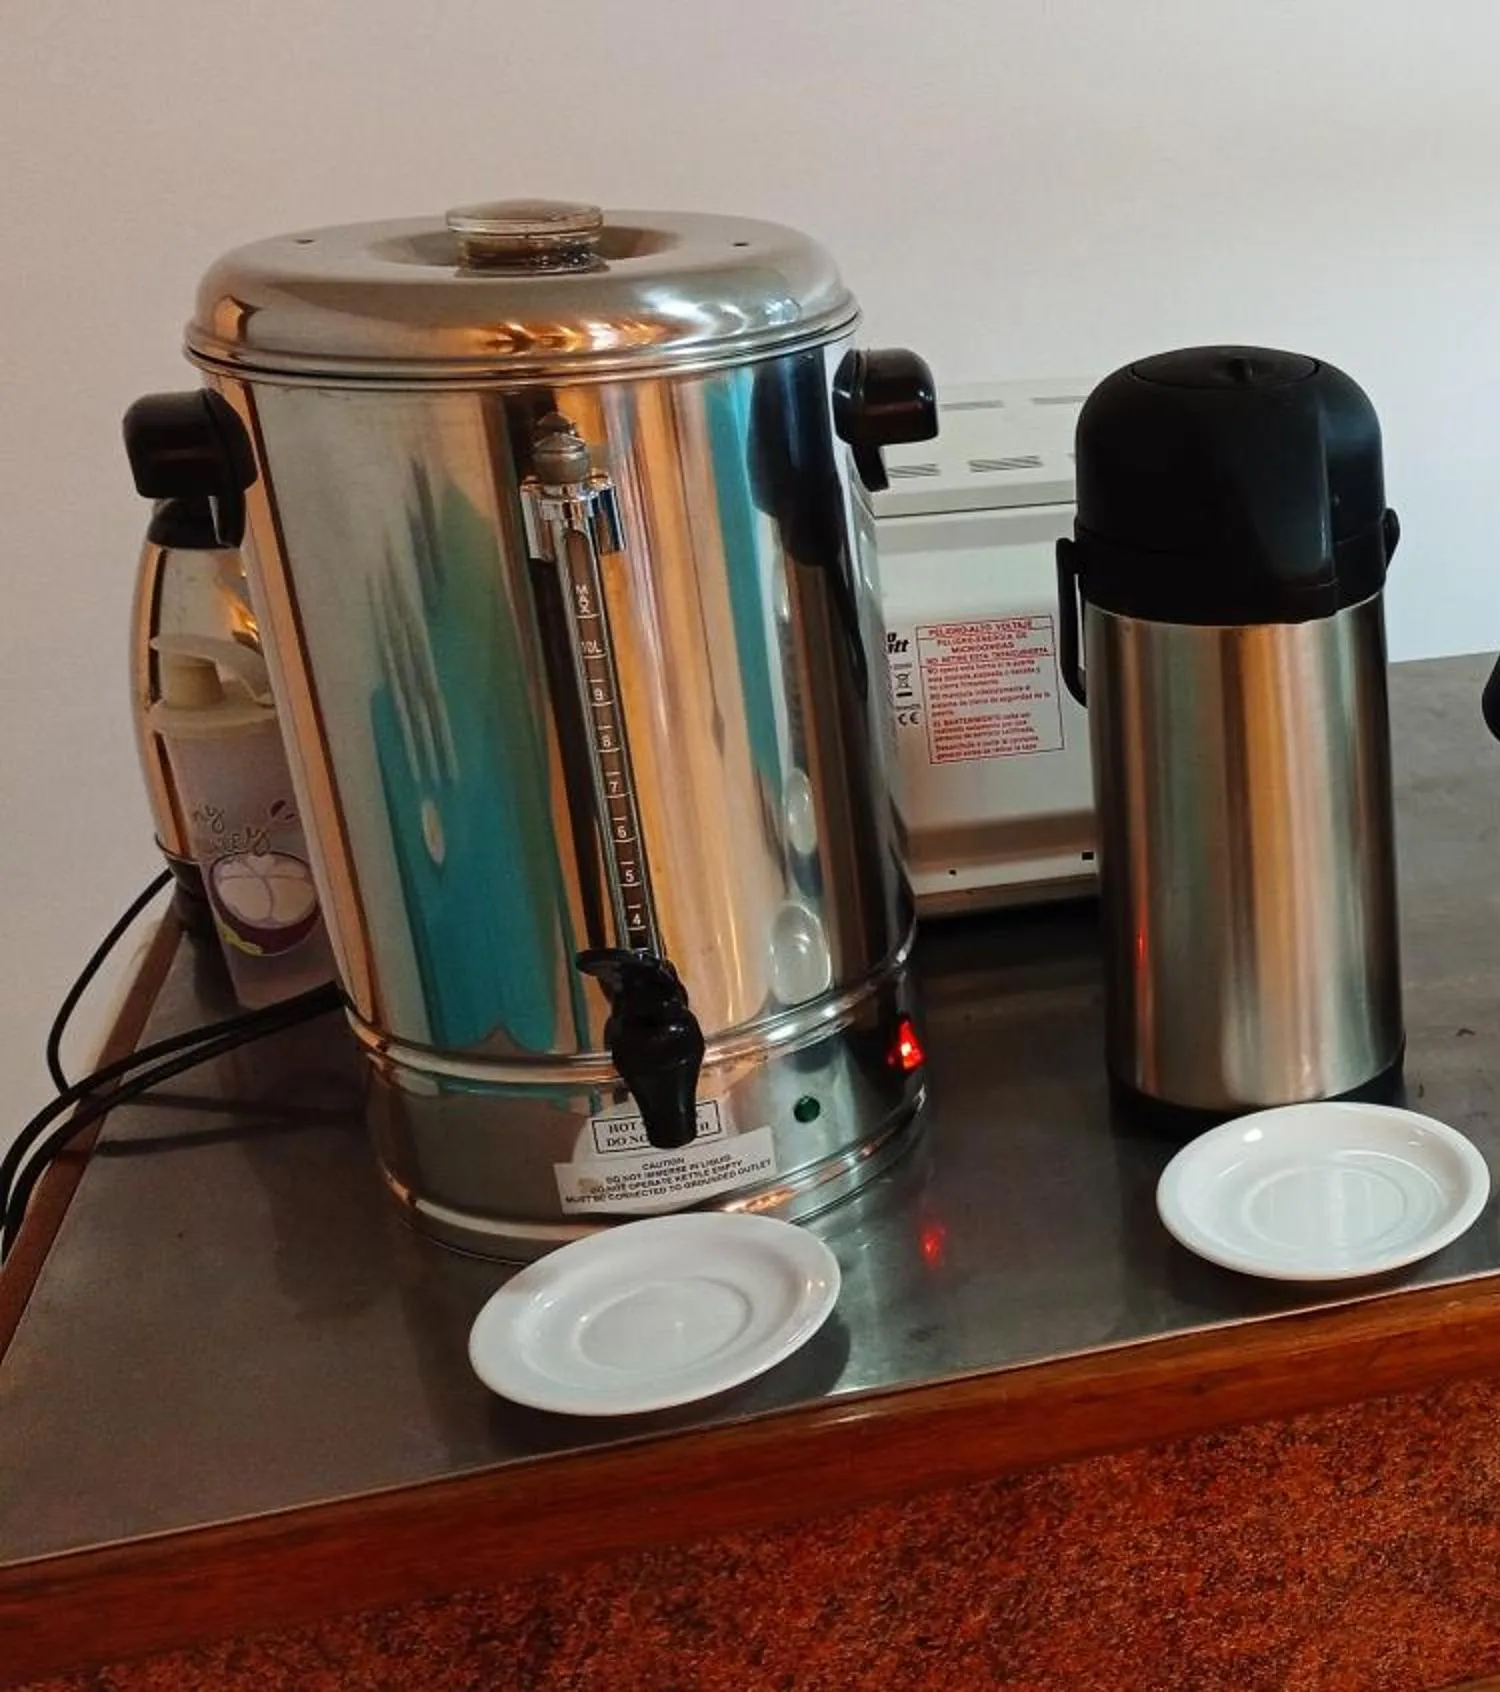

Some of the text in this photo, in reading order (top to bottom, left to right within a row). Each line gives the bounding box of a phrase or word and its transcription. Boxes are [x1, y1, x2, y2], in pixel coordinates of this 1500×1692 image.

[609, 781, 619, 793] 7
[616, 825, 627, 838] 6
[625, 869, 635, 882] 5
[632, 913, 642, 925] 4
[608, 1121, 636, 1133] HOT
[641, 1157, 685, 1170] CAUTION
[711, 1159, 743, 1174] EMPTY
[607, 1186, 667, 1200] CONNECTED
[737, 1158, 771, 1175] OUTLET
[622, 1173, 641, 1182] NOT
